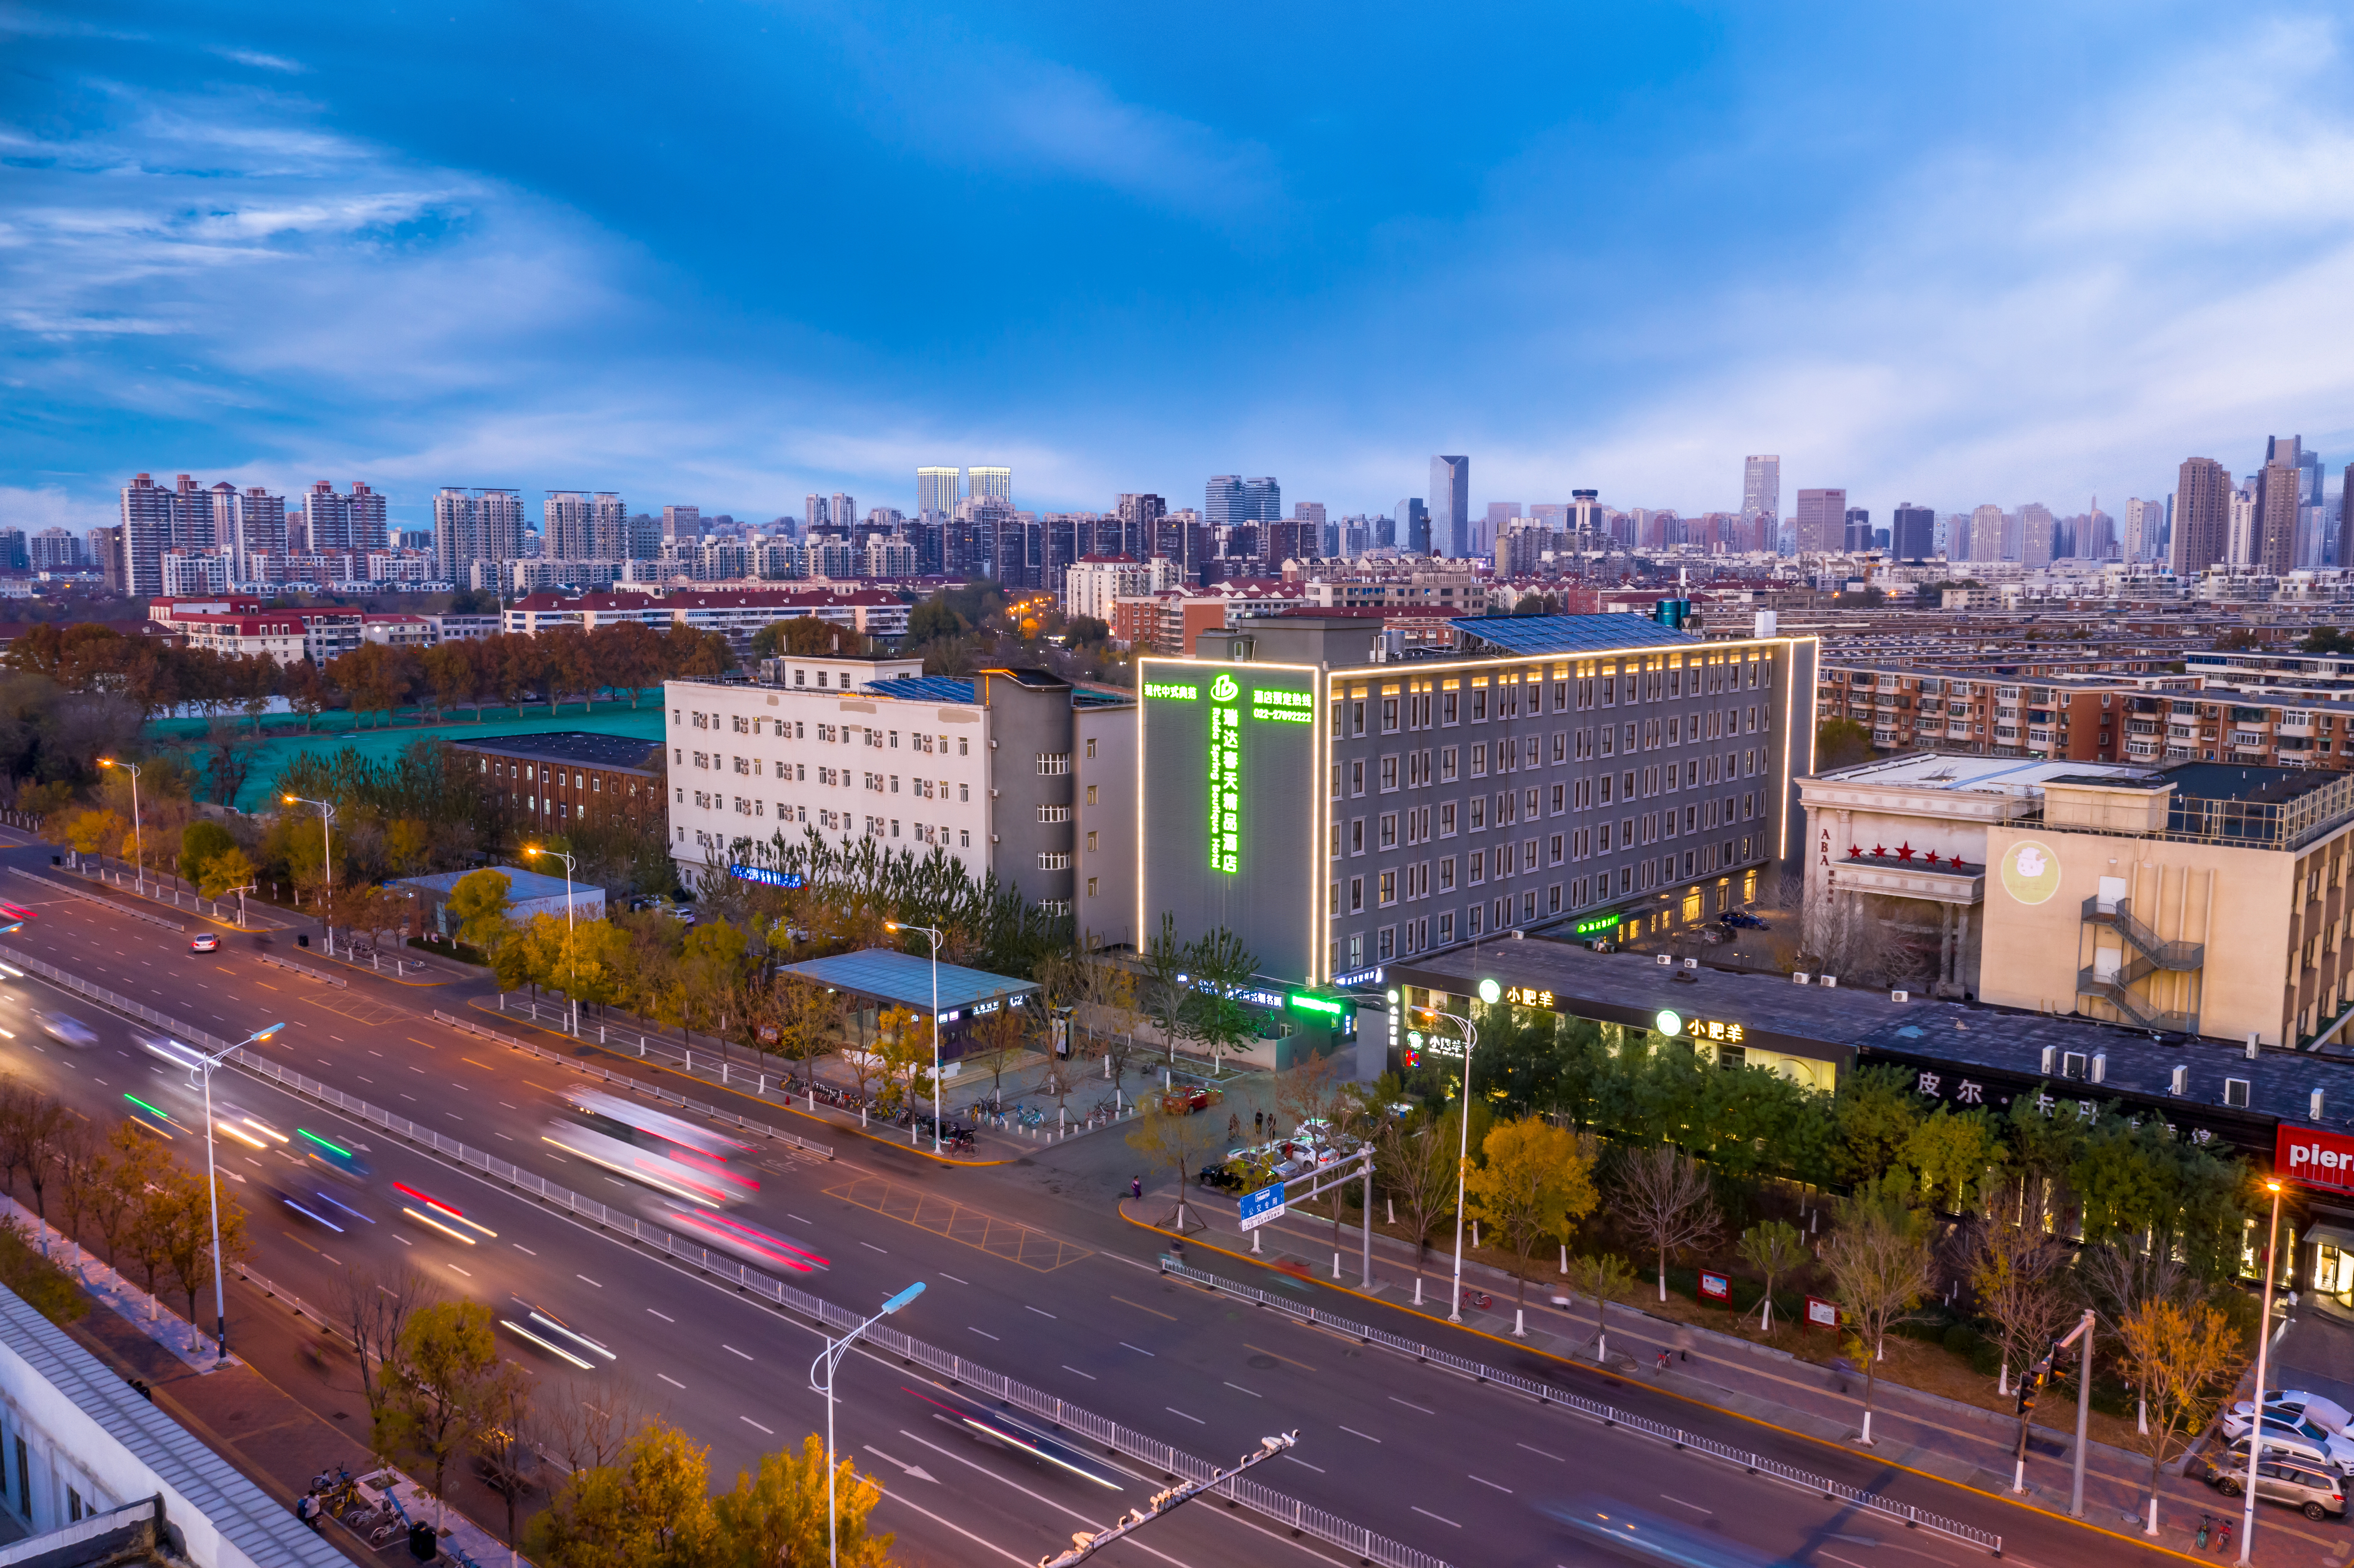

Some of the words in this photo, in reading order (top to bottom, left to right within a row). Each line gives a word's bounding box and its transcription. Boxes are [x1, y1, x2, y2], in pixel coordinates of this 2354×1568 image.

[1144, 684, 1197, 699] 现代中式典范
[1253, 690, 1311, 707] 酒店预定热线
[1212, 707, 1221, 740] Ruida
[1210, 744, 1221, 780] Spring
[1223, 708, 1238, 873] 瑞达春天精品酒店
[1210, 784, 1221, 834] Boutique
[1211, 838, 1221, 868] Hotel
[1820, 828, 1831, 866] ABA
[1507, 986, 1553, 1008] 小肥羊
[1688, 1019, 1743, 1042] 小肥羊
[2289, 1143, 2354, 1172] pier
[1248, 1197, 1277, 1216] 公交专用
